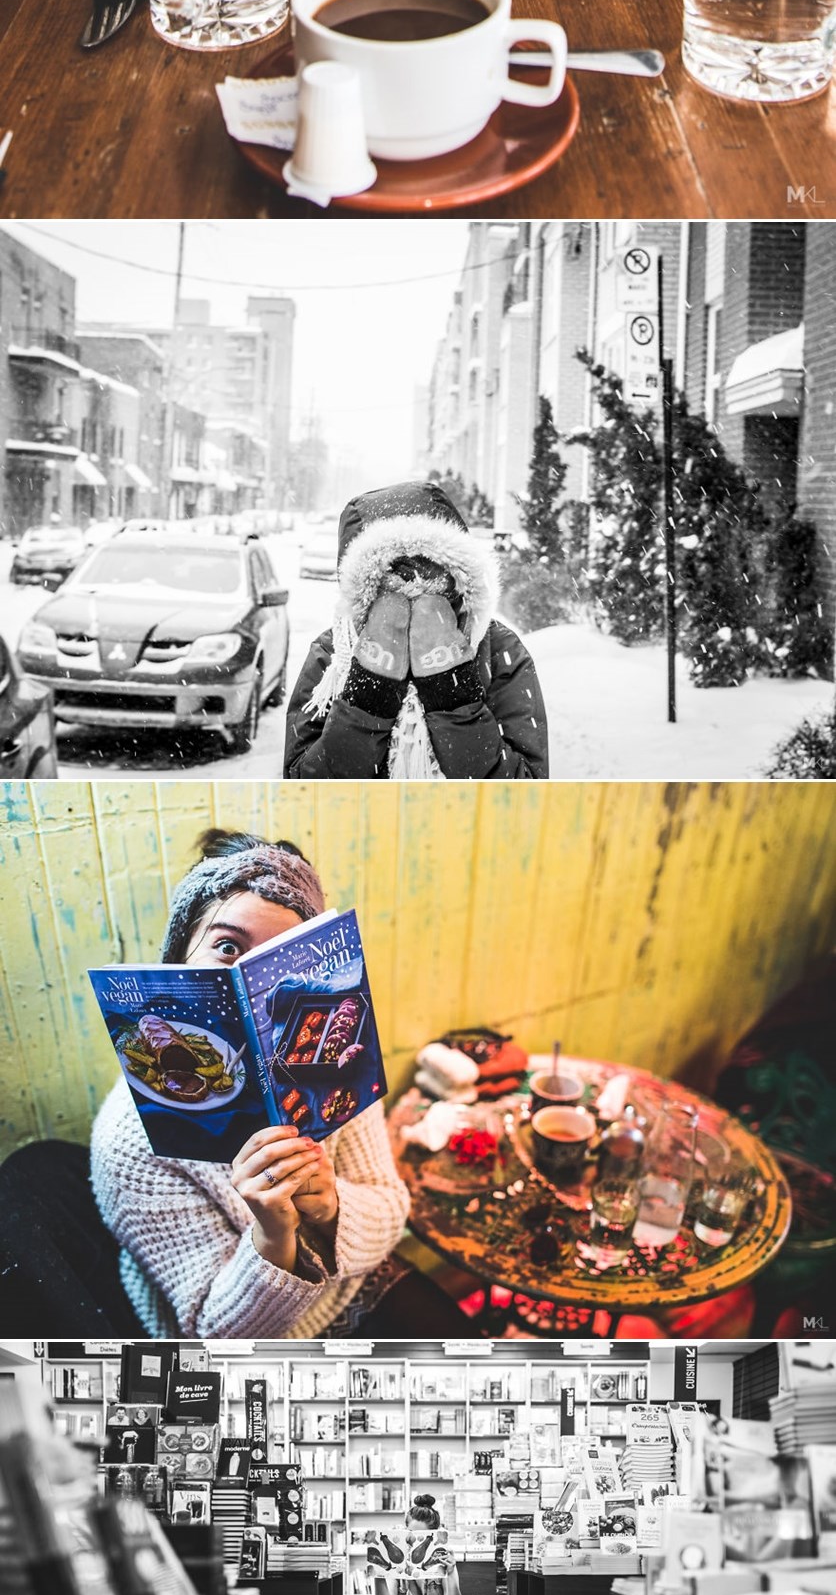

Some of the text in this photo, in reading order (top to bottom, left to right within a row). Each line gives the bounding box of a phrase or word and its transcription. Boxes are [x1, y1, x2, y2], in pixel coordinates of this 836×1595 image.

[308, 928, 347, 963] Noël
[299, 948, 351, 986] vegan
[107, 977, 140, 991] Noël
[101, 988, 144, 1005] vegan
[685, 1358, 696, 1390] CUISINE
[175, 1384, 213, 1393] Mon livre
[641, 1413, 660, 1422] 265
